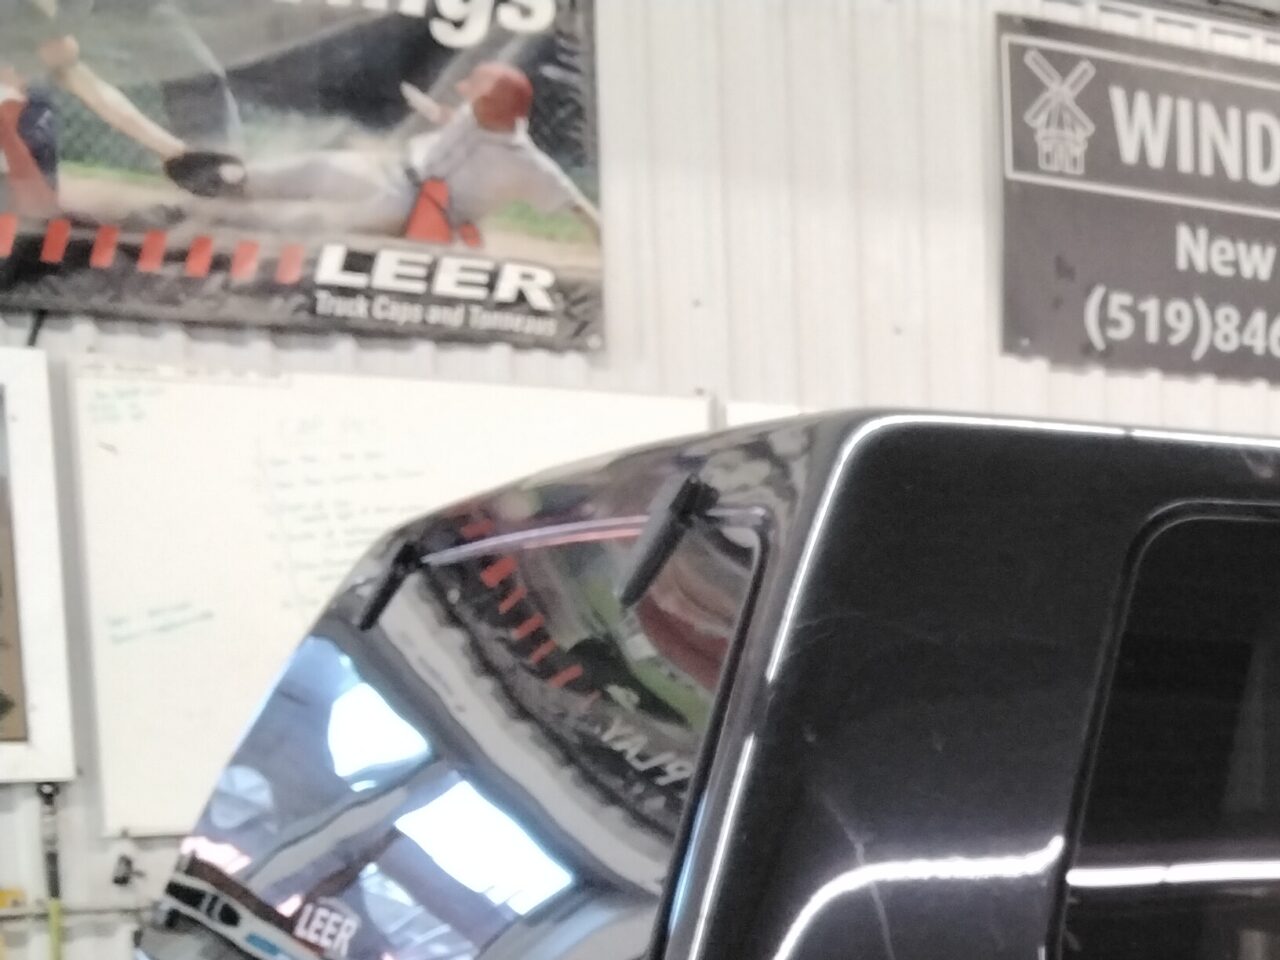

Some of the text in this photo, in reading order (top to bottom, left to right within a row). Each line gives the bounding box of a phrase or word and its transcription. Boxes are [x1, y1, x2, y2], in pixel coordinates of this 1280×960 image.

[315, 244, 556, 312] LEER
[1174, 221, 1277, 282] New
[315, 289, 369, 319] Truck
[371, 295, 424, 325] Caps
[425, 304, 465, 328] and
[293, 903, 359, 957] LEER
